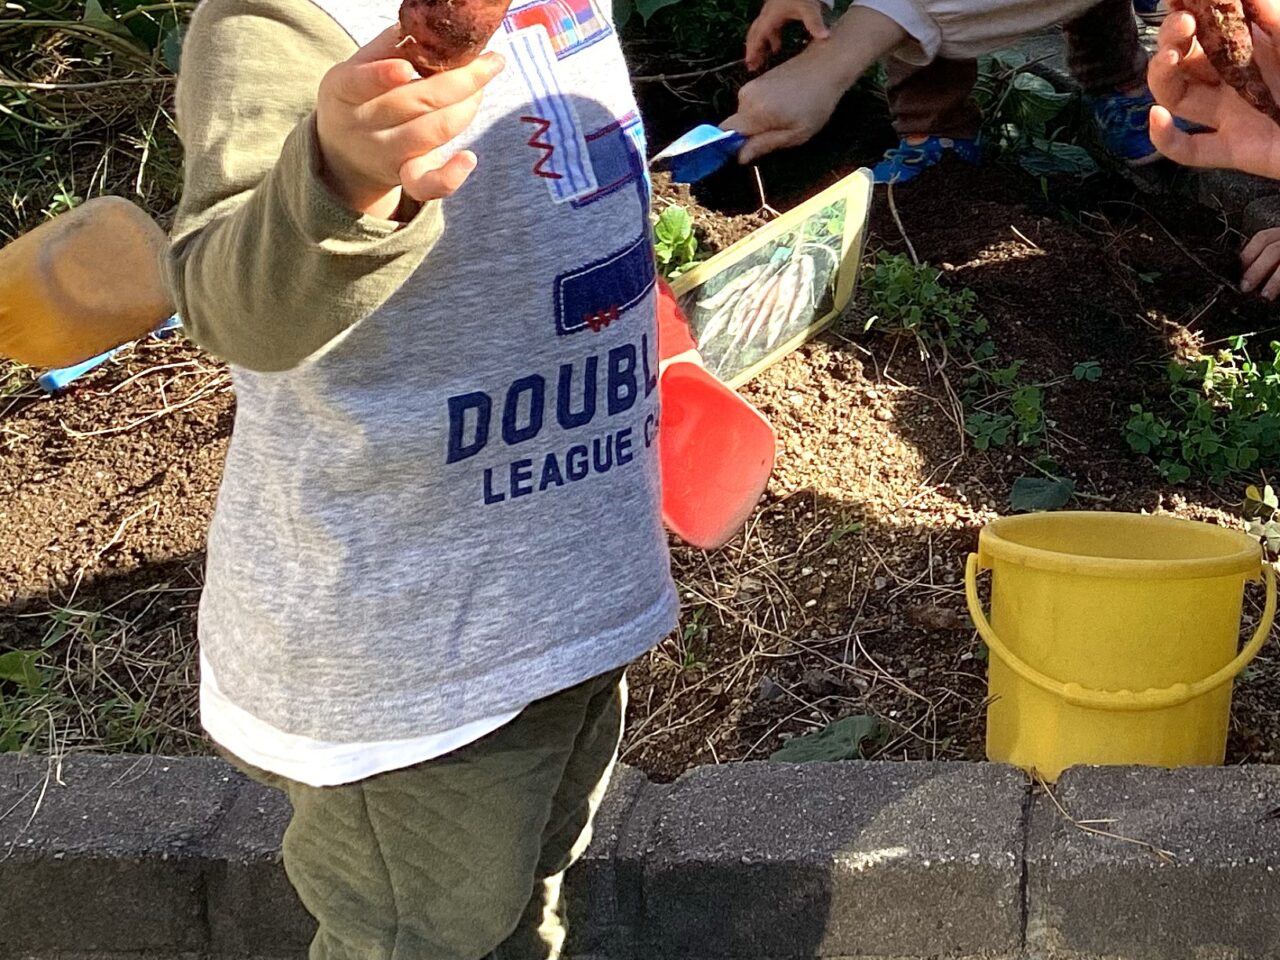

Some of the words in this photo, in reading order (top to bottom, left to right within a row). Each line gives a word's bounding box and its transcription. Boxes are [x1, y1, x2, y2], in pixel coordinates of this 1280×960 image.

[446, 333, 657, 464] DOUBL
[483, 427, 633, 505] LEAGUE
[644, 412, 659, 448] C
